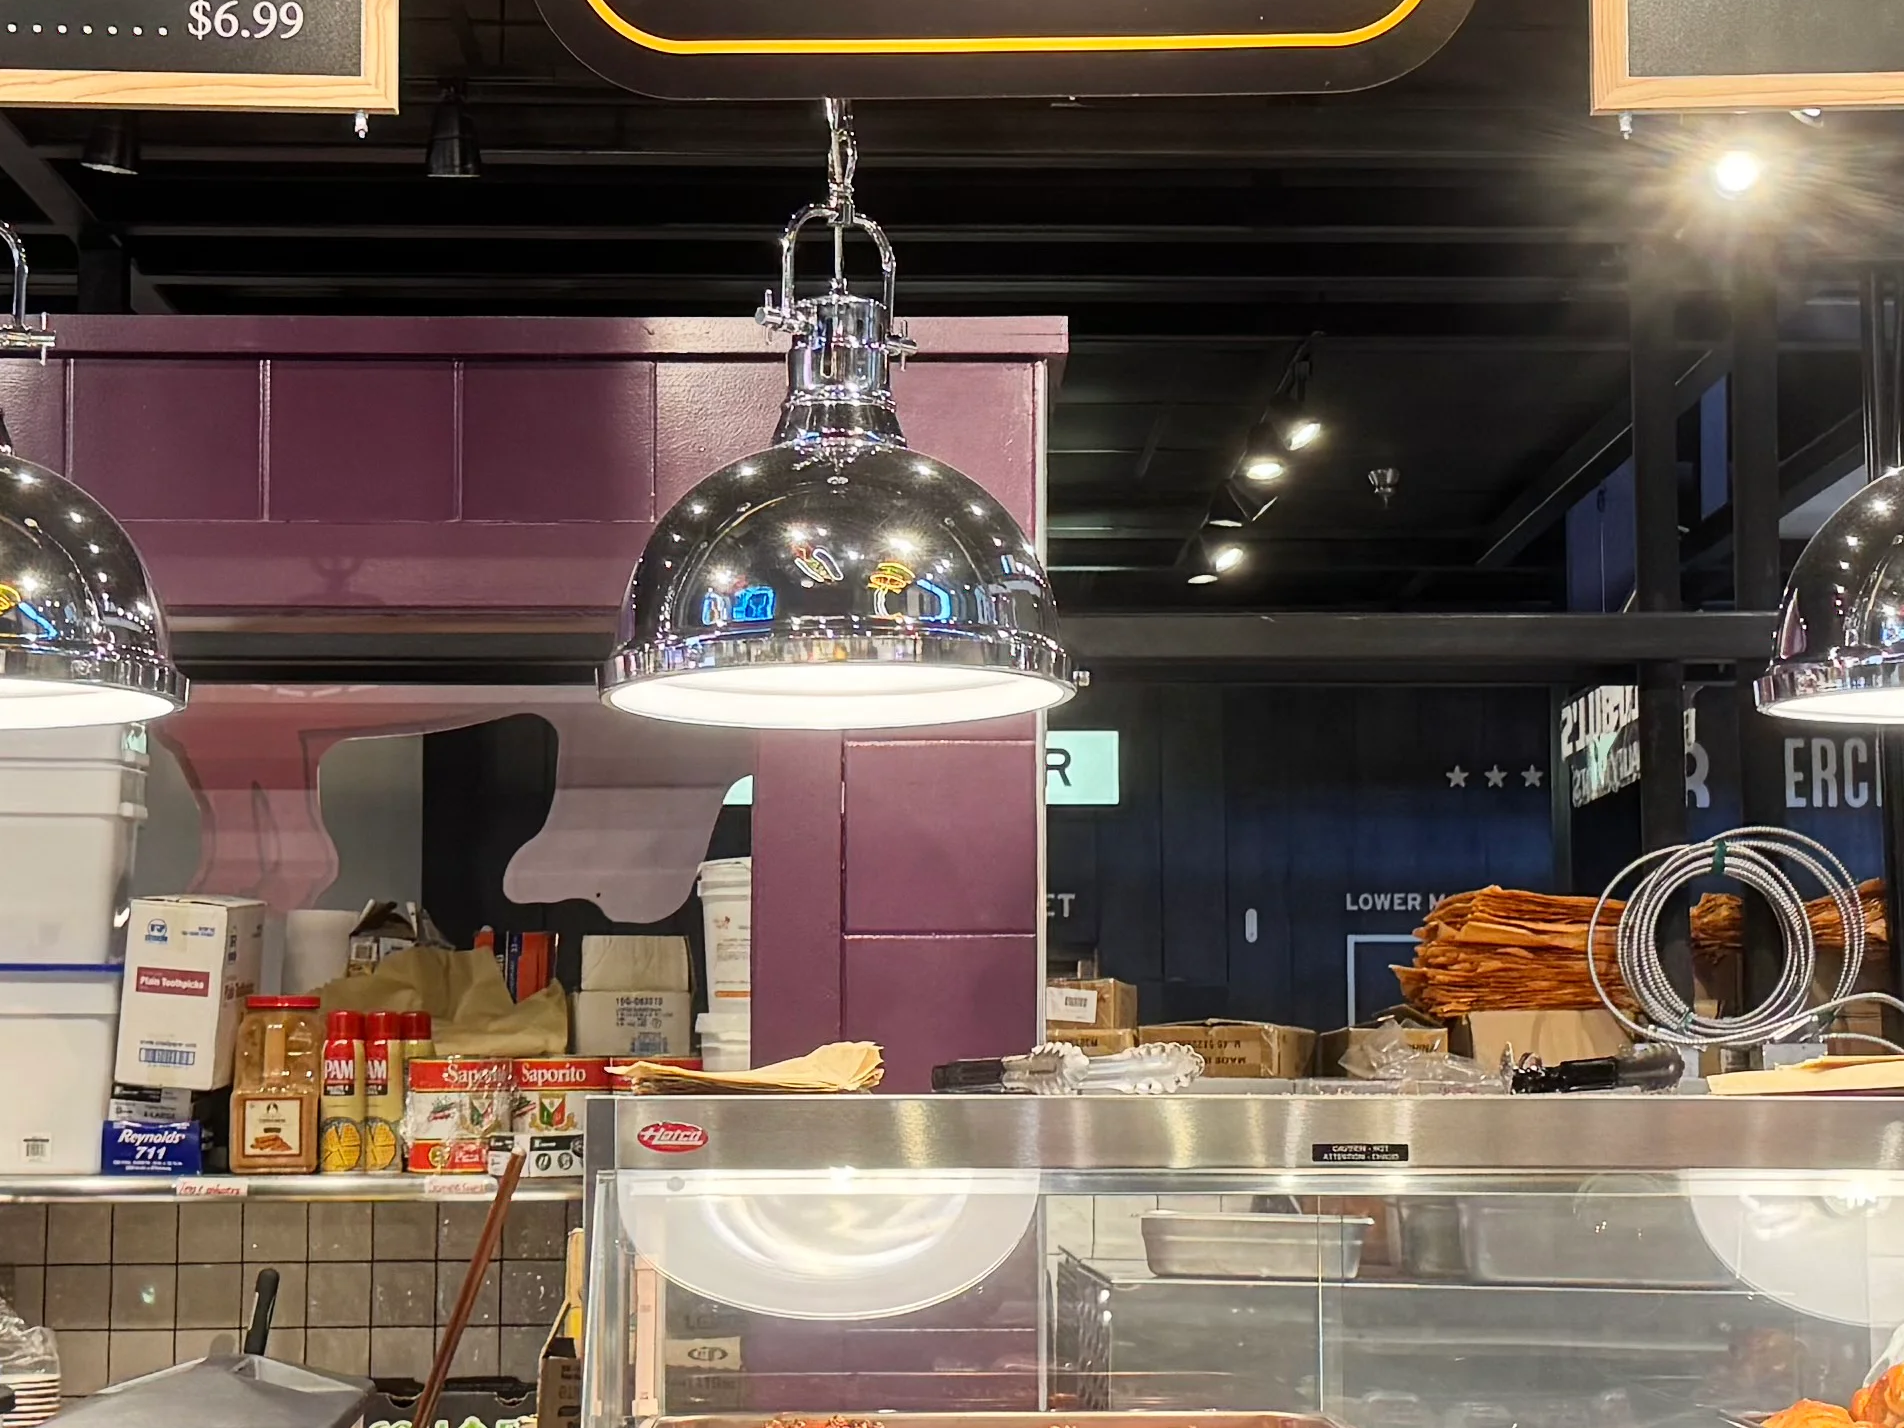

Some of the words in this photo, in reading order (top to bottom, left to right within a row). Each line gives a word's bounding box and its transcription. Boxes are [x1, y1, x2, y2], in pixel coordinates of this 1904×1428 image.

[1346, 893, 1421, 911] LOWER
[324, 1059, 354, 1080] PAM
[366, 1059, 387, 1080] AM
[522, 1063, 586, 1087] Saporito
[118, 1129, 181, 1146] Reynolds
[135, 1146, 167, 1160] 711
